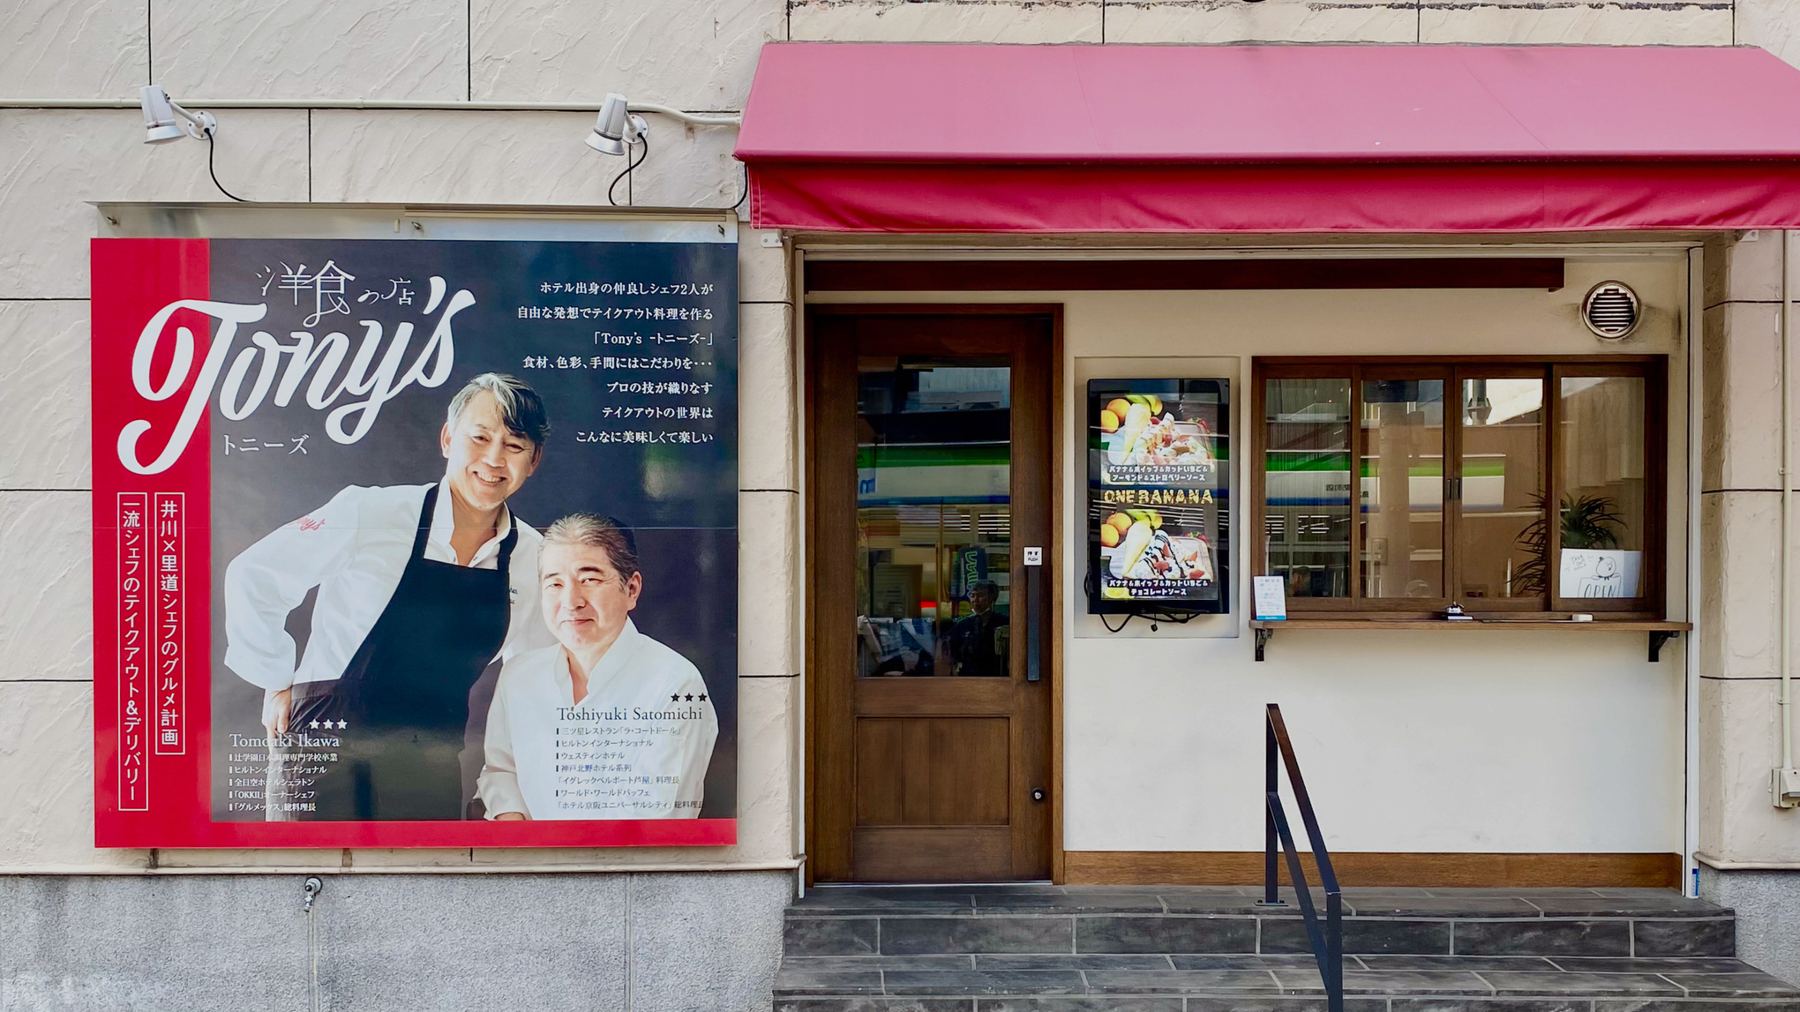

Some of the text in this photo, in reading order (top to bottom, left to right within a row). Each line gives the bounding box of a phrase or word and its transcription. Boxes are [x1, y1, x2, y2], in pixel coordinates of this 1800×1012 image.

[256, 260, 415, 327] 洋食の店
[540, 282, 713, 295] ホテル出身の仲良しシェフ2人が
[518, 306, 713, 320] 自由な発想でテイクアウト料理を作る
[117, 276, 476, 475] Tony's
[607, 382, 713, 394] プロの技が織りなす
[602, 407, 713, 419] テイクアウトの世界は
[224, 434, 310, 455] トニーズ
[576, 431, 713, 444] こんなに美味しくて楽しい
[1104, 489, 1135, 503] ONE
[160, 500, 179, 746] 井川×里道シェフのグルメ計画
[122, 502, 141, 801] 一流シェフのテイクアウト&デリバリー
[556, 707, 702, 724] Toshiyuki Satomichi
[298, 733, 340, 747] Ikawa
